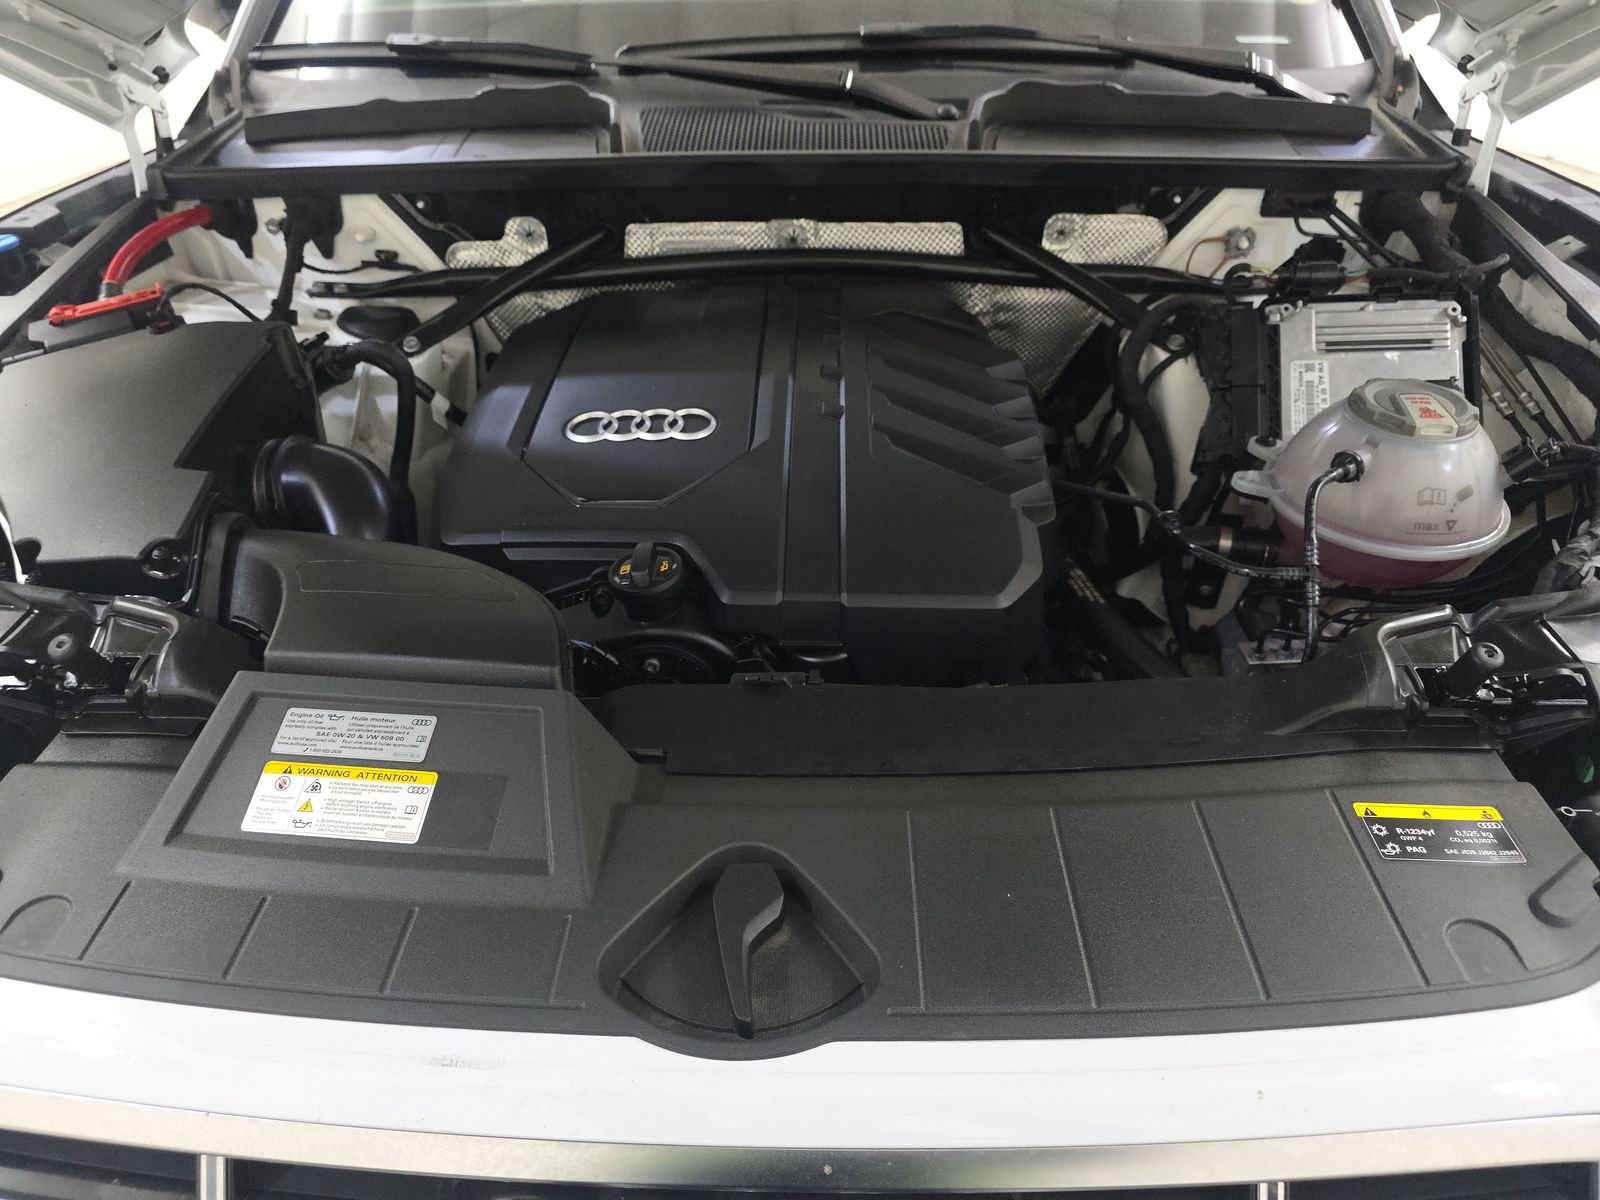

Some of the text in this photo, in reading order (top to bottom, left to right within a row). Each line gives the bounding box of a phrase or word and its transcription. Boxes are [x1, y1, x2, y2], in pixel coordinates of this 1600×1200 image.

[1413, 522, 1440, 531] max
[297, 767, 418, 782] WARNING ATTENTION
[1395, 827, 1436, 837] R-1234yf
[1480, 830, 1494, 838] kg
[1405, 846, 1428, 854] PAG
